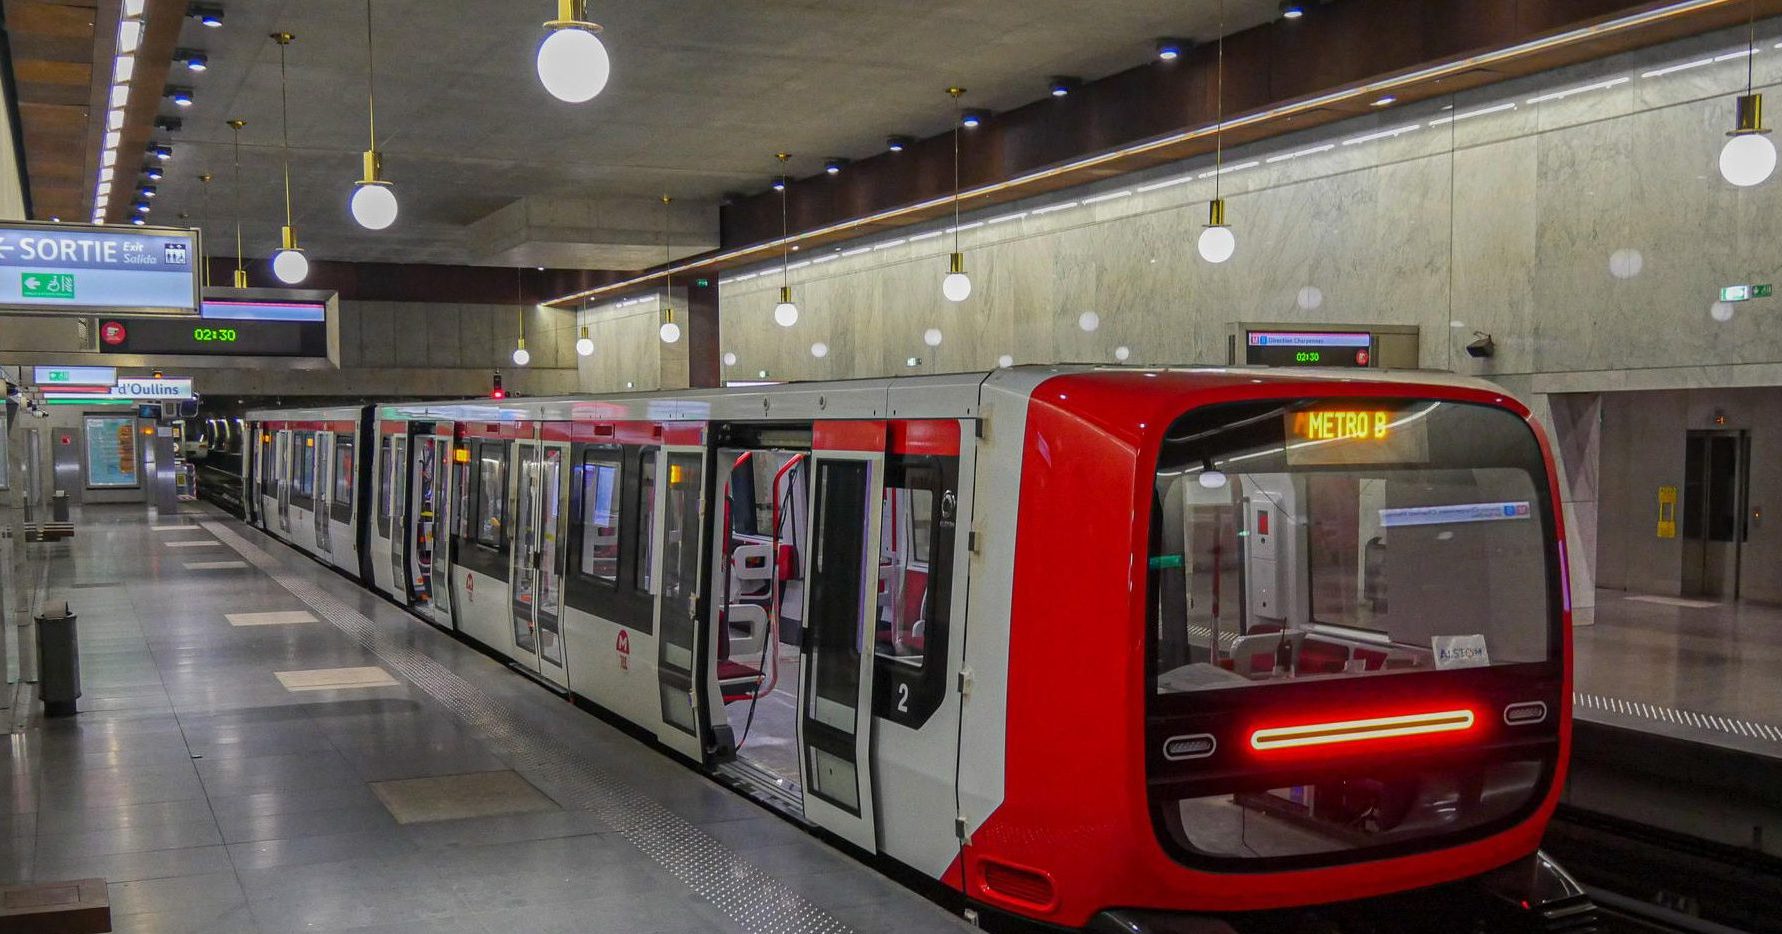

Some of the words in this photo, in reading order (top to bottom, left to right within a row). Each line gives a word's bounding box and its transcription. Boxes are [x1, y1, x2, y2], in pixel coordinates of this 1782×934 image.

[19, 237, 118, 263] SORTIE
[123, 241, 144, 252] Exit
[123, 253, 158, 264] Salida
[193, 328, 237, 342] 02:30
[1268, 337, 1292, 345] Direction
[1296, 352, 1320, 362] 02:30
[118, 383, 179, 396] d'Oullins
[1308, 411, 1369, 439] METRO
[1374, 411, 1387, 439] B
[897, 682, 909, 713] 2
